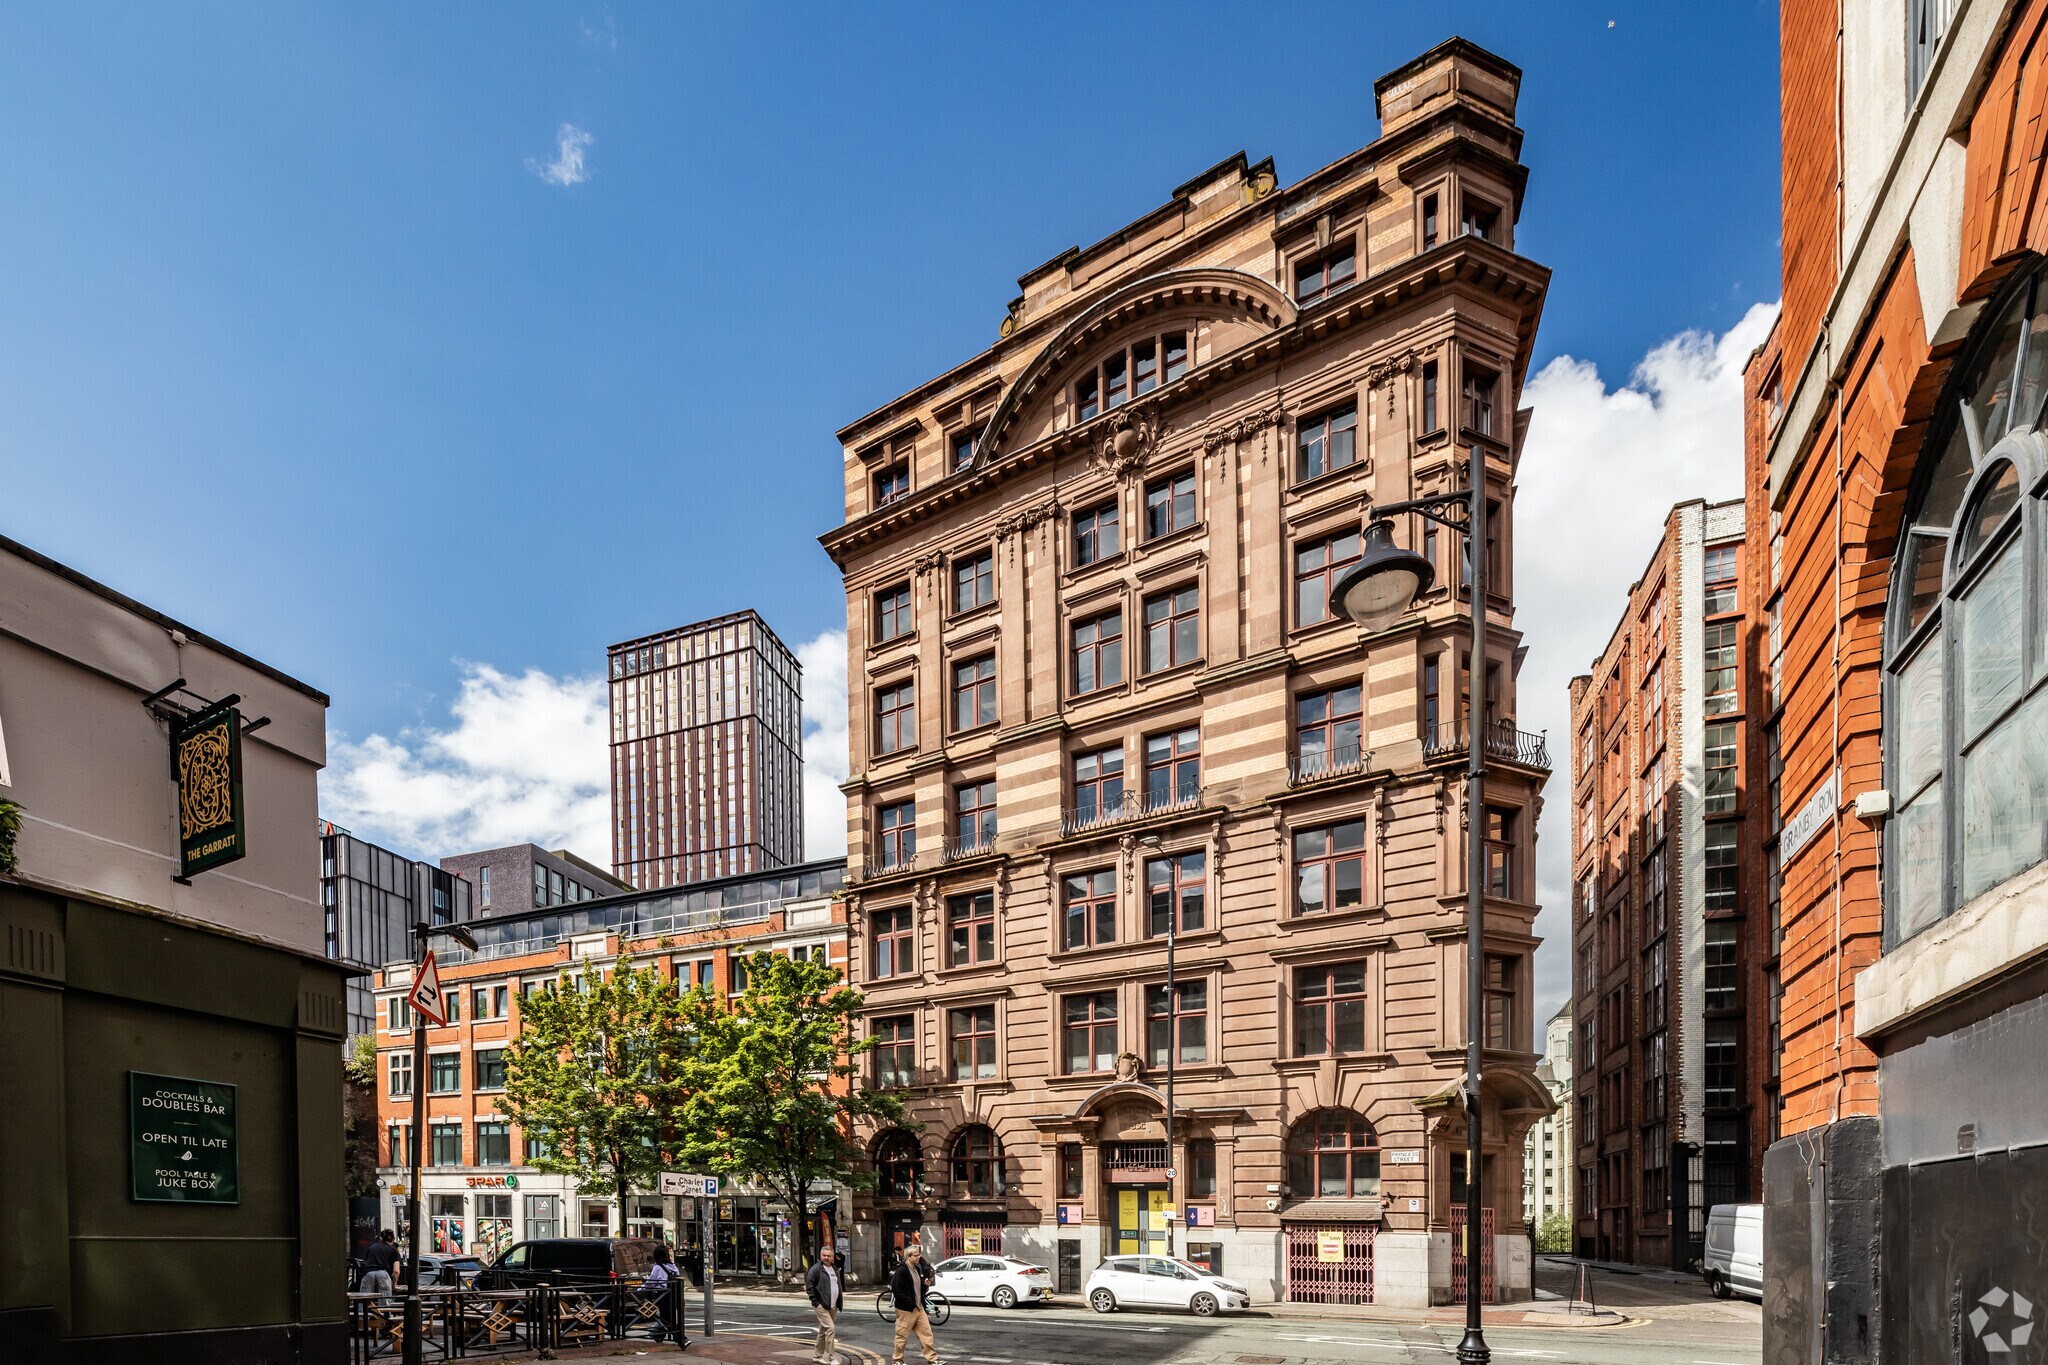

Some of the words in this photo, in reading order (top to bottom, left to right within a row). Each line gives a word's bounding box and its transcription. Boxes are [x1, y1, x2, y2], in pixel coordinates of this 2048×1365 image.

[1783, 808, 1814, 854] GRANBY
[187, 847, 201, 861] THE
[202, 834, 235, 855] GARRATT
[155, 1091, 205, 1103] COCKTAILS
[206, 1096, 213, 1104] &
[142, 1097, 200, 1112] DOUBLES
[203, 1104, 225, 1115] BAR
[142, 1132, 178, 1144] OPEN
[181, 1136, 198, 1146] TIL
[202, 1138, 228, 1148] LATE
[155, 1169, 181, 1178] POOL
[184, 1170, 208, 1179] TABLE
[210, 1172, 217, 1180] &
[465, 1176, 505, 1186] SPAR
[157, 1178, 187, 1188] JUKE
[191, 1180, 216, 1189] BOX
[679, 1177, 704, 1186] Charles
